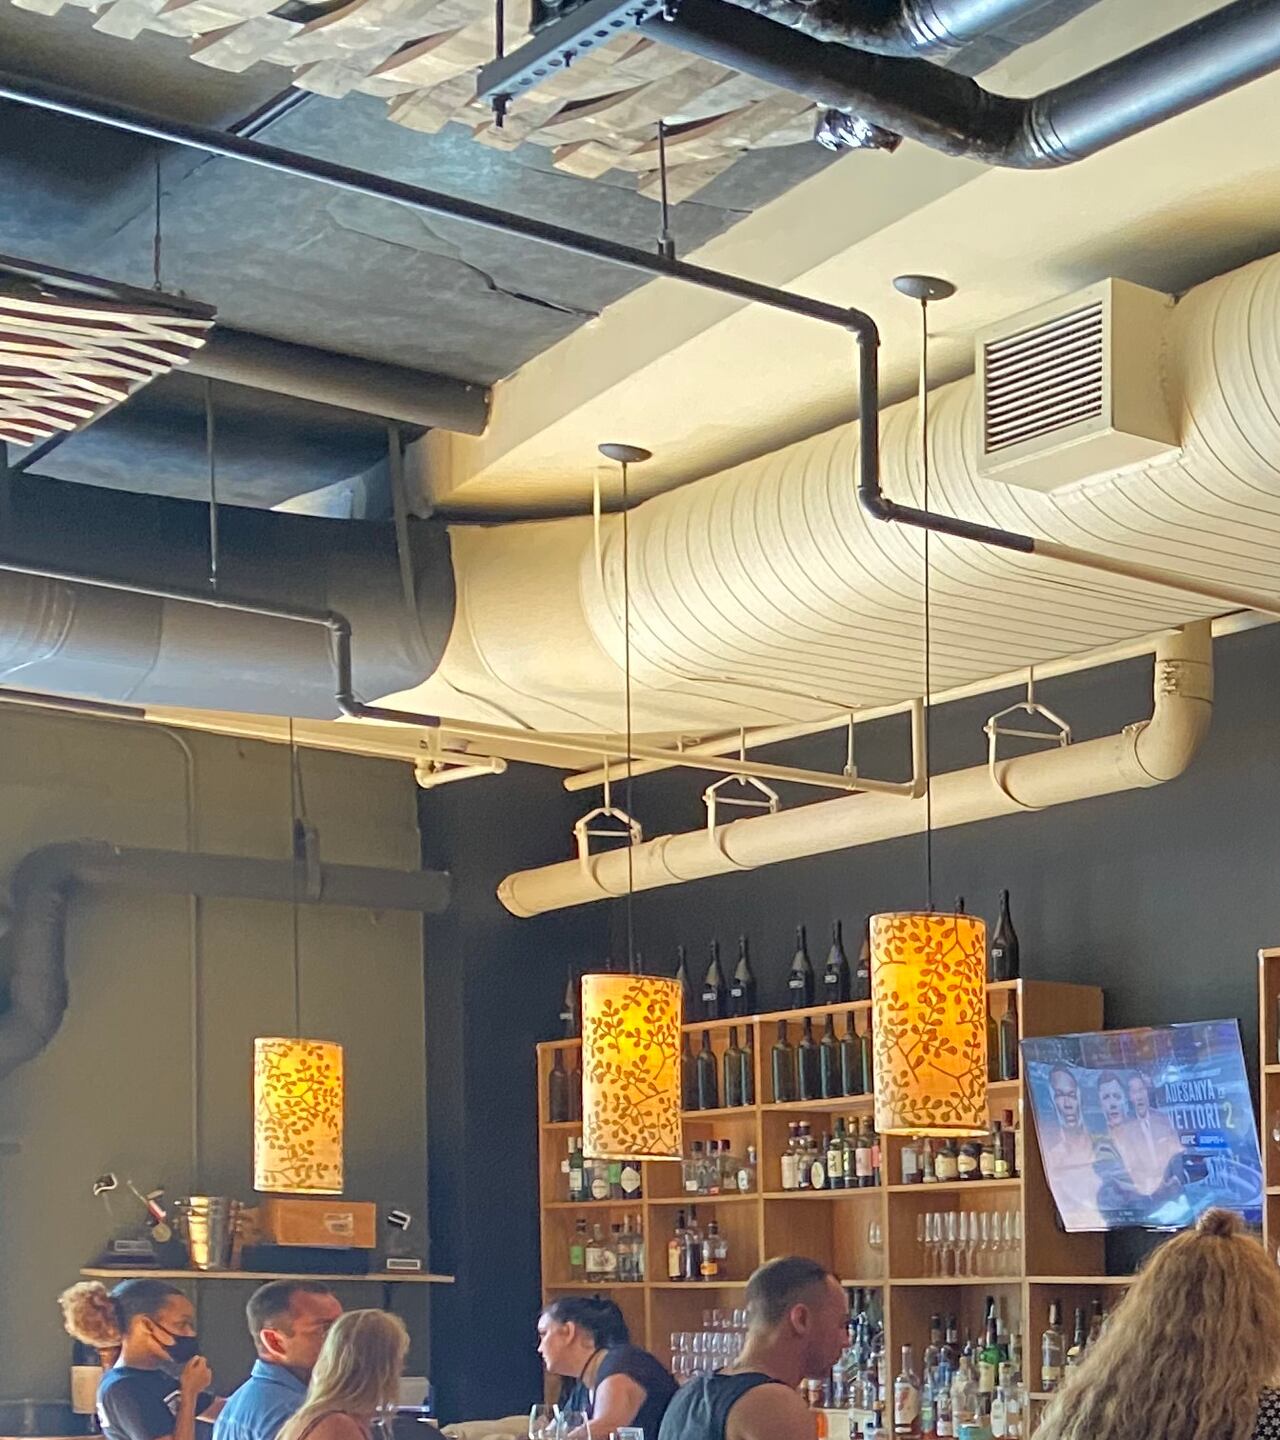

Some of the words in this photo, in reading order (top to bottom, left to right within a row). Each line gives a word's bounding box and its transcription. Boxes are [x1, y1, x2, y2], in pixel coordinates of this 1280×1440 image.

[1164, 1079, 1216, 1104] ADESANYA
[1167, 1102, 1221, 1130] VETTORI
[1223, 1101, 1236, 1129] 2
